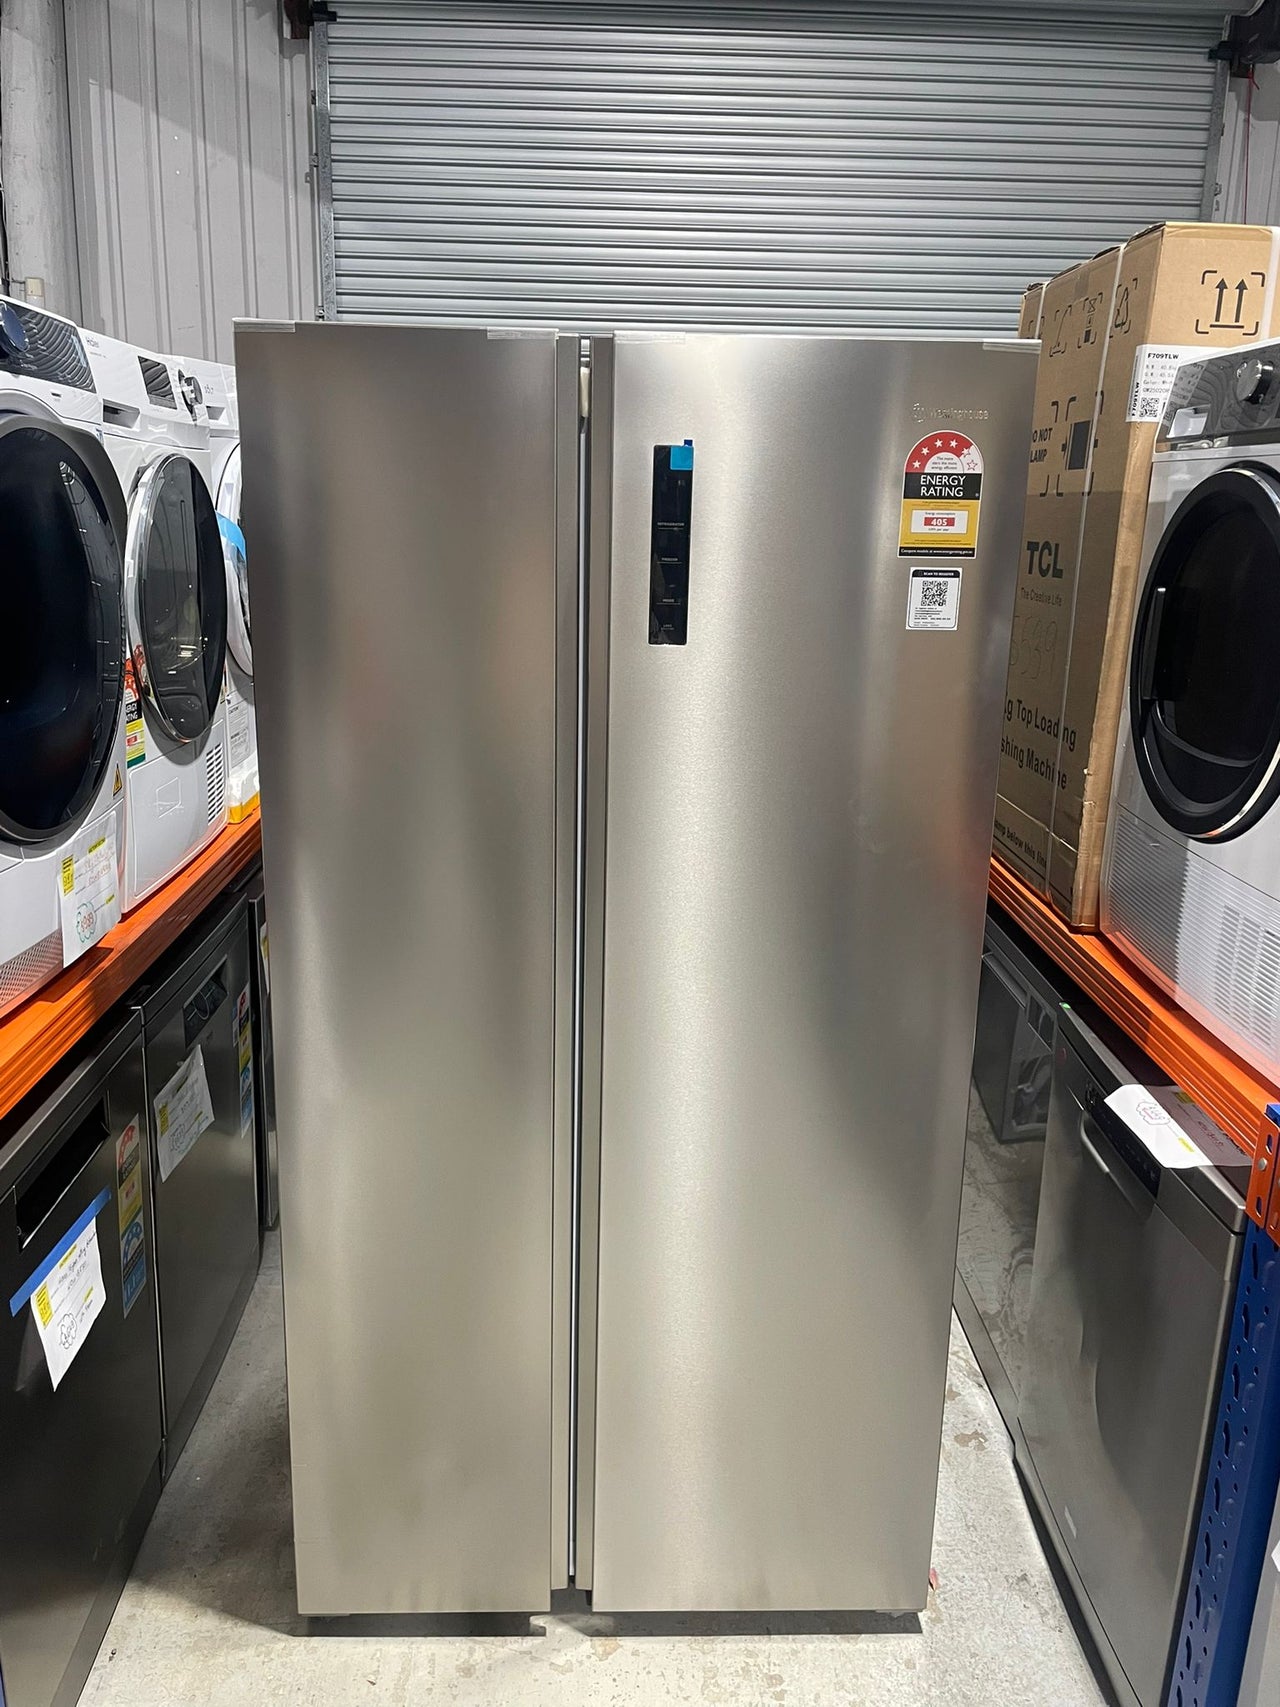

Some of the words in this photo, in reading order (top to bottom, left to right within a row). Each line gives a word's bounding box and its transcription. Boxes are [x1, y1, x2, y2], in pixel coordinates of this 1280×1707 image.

[1148, 352, 1180, 360] F709TLW
[1032, 430, 1038, 442] O
[1038, 427, 1053, 442] NOT
[1030, 448, 1048, 463] LAMP
[920, 474, 966, 486] ENERGY
[920, 486, 964, 497] RATING
[930, 518, 948, 526] 405
[1026, 540, 1064, 579] TCL
[1030, 589, 1051, 605] Creative
[1052, 592, 1062, 606] Life
[1016, 699, 1032, 728] Top
[1034, 707, 1076, 752] Loadng
[1000, 736, 1024, 768] shing
[1006, 826, 1024, 848] below
[1024, 841, 1035, 860] this
